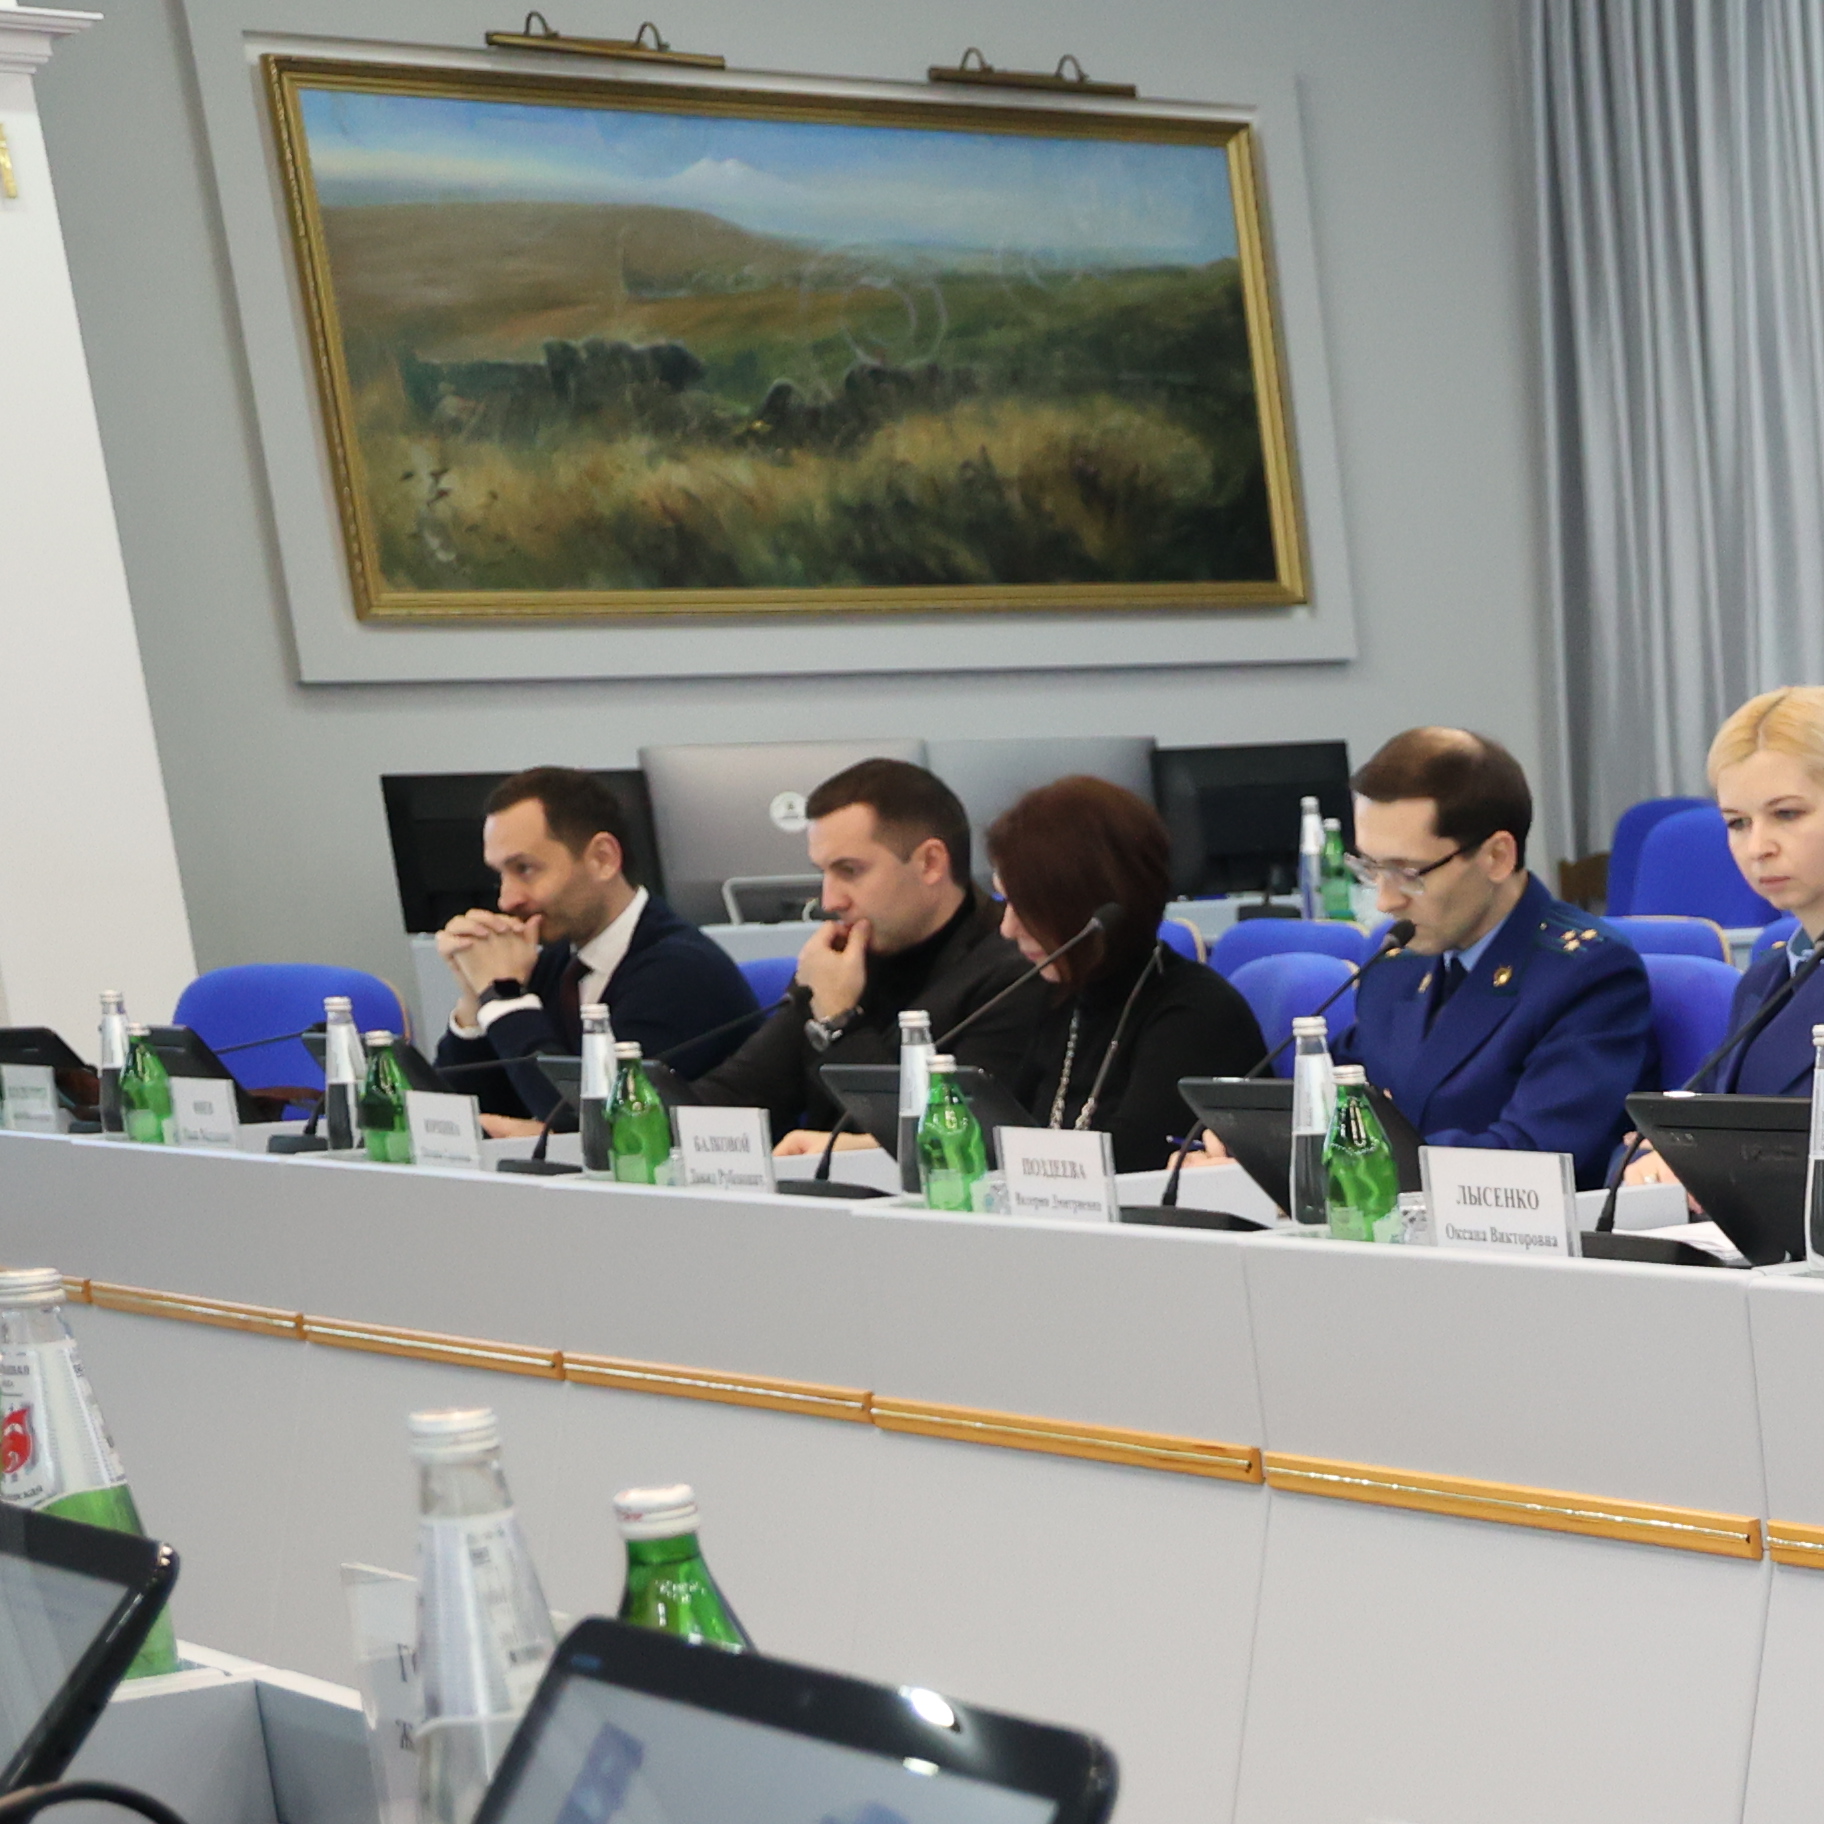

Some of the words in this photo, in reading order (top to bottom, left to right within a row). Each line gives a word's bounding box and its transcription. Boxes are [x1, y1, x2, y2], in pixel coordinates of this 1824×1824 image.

[1456, 1185, 1540, 1210] ЛЫСЕНКО
[1445, 1223, 1487, 1242] Оксана
[1490, 1226, 1559, 1250] Викторовна
